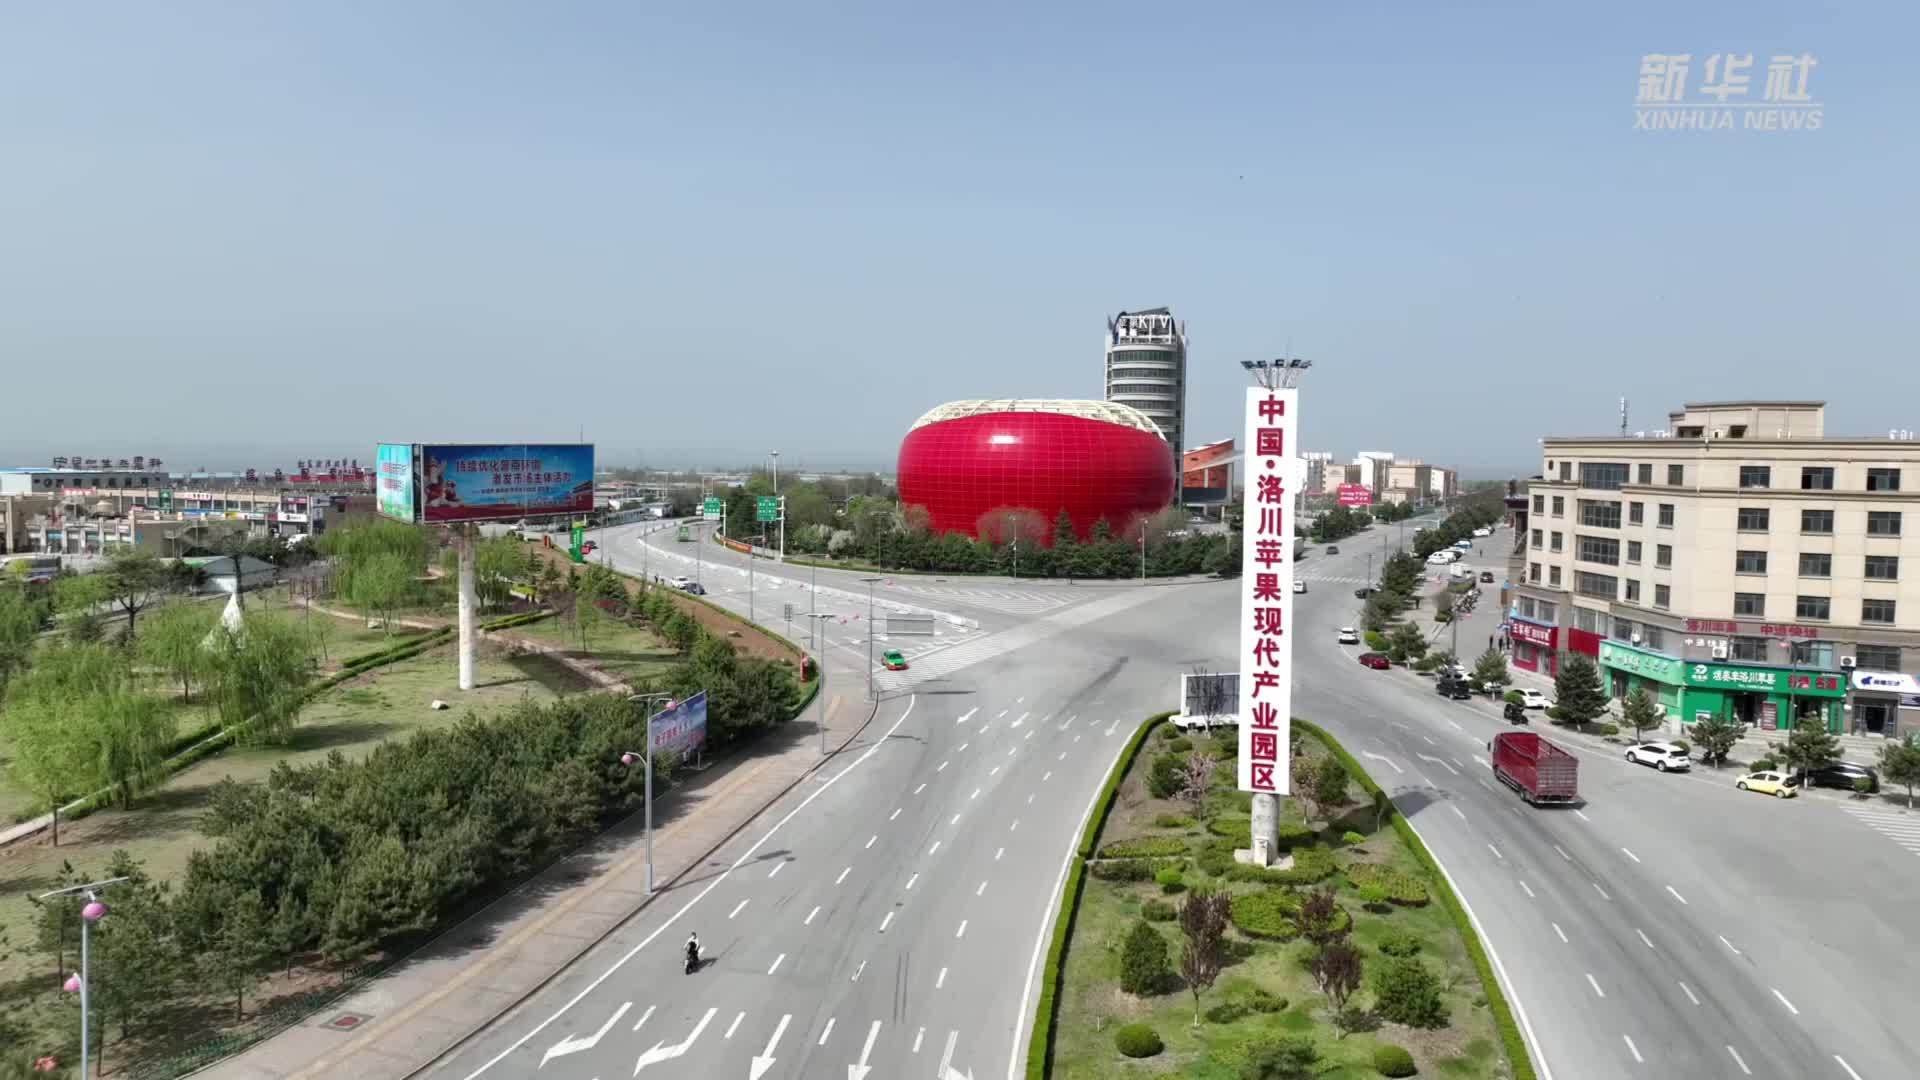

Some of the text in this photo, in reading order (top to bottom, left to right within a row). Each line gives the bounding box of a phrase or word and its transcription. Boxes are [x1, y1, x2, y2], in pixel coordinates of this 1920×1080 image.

[1251, 394, 1285, 791] 中国·洛川苹果现代产业园区
